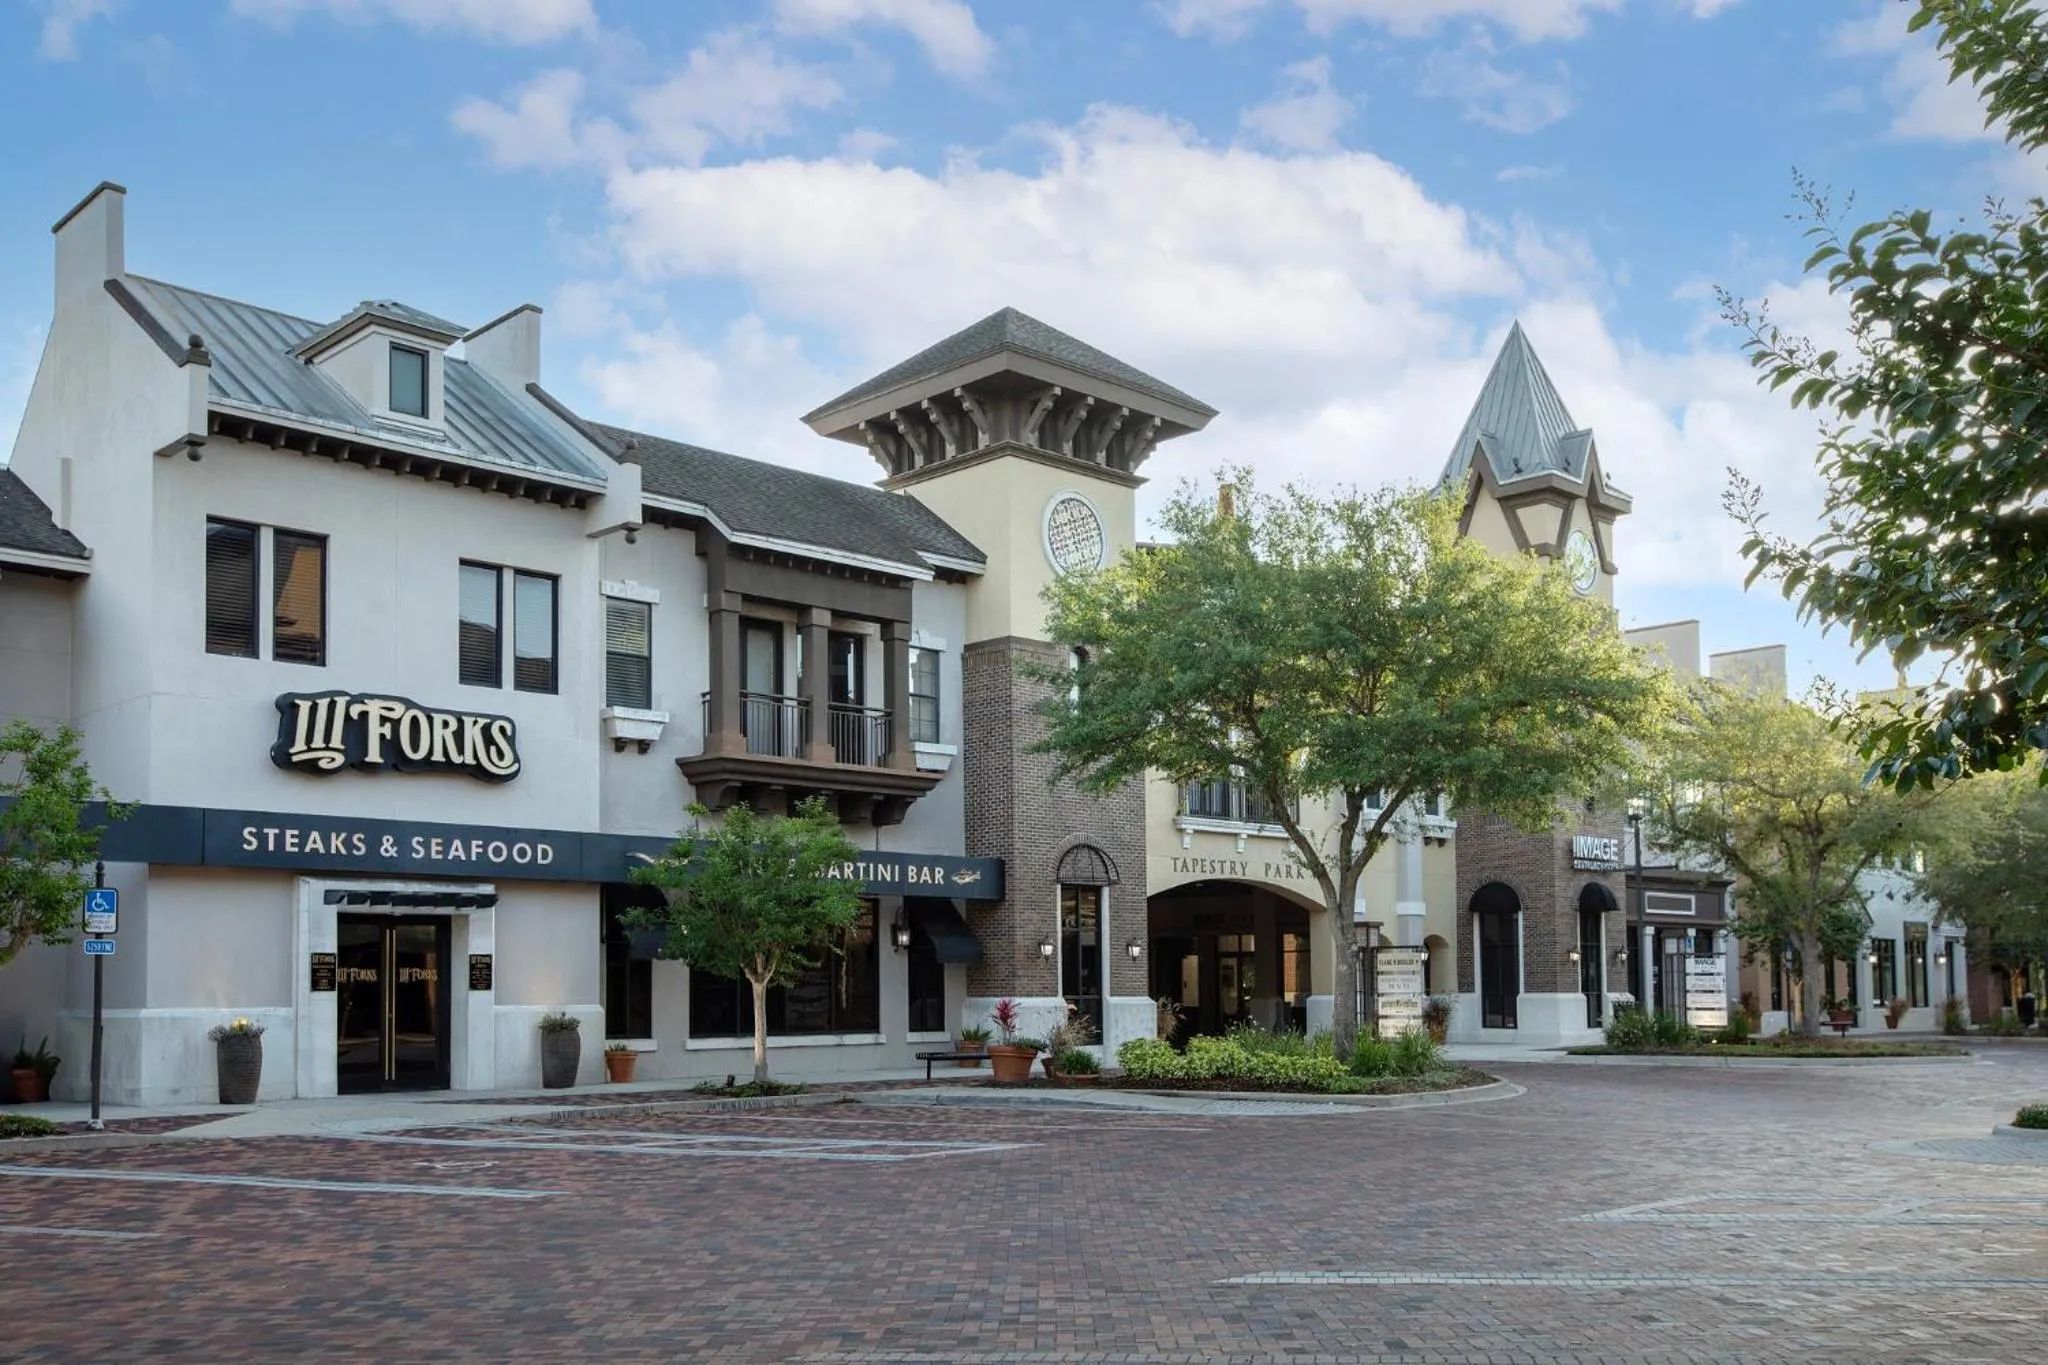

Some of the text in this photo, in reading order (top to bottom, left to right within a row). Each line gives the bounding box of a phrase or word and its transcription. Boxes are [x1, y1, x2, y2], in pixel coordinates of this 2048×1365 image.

[289, 695, 519, 775] III FORKS
[242, 826, 554, 865] STEAKS & SEAFOOD
[1572, 835, 1619, 861] IMAGE
[907, 865, 945, 884] BAR
[1170, 856, 1305, 880] TAPESTRY PARK
